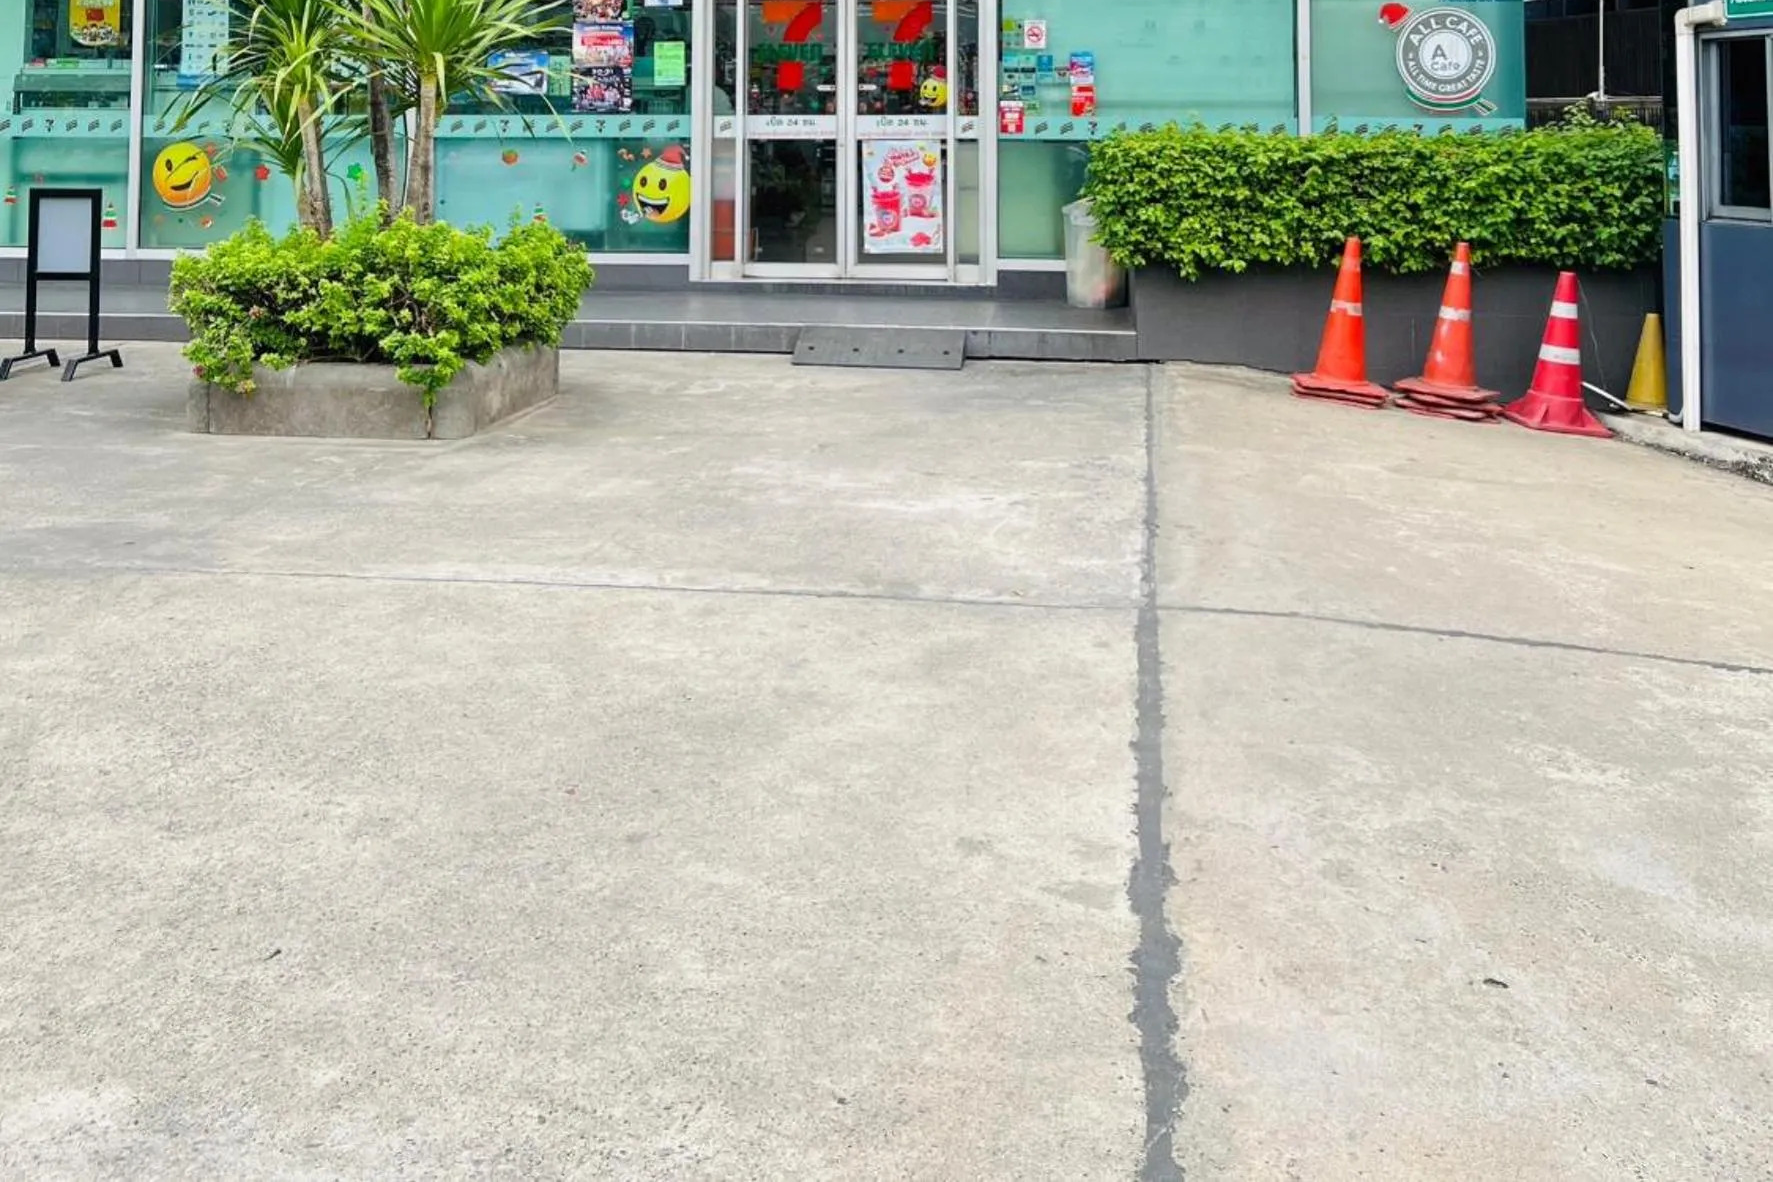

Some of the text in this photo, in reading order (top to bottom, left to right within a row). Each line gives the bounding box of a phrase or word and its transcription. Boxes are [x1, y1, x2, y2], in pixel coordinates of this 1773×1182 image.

[1409, 16, 1483, 46] ALL CAFE
[1432, 44, 1448, 60] A
